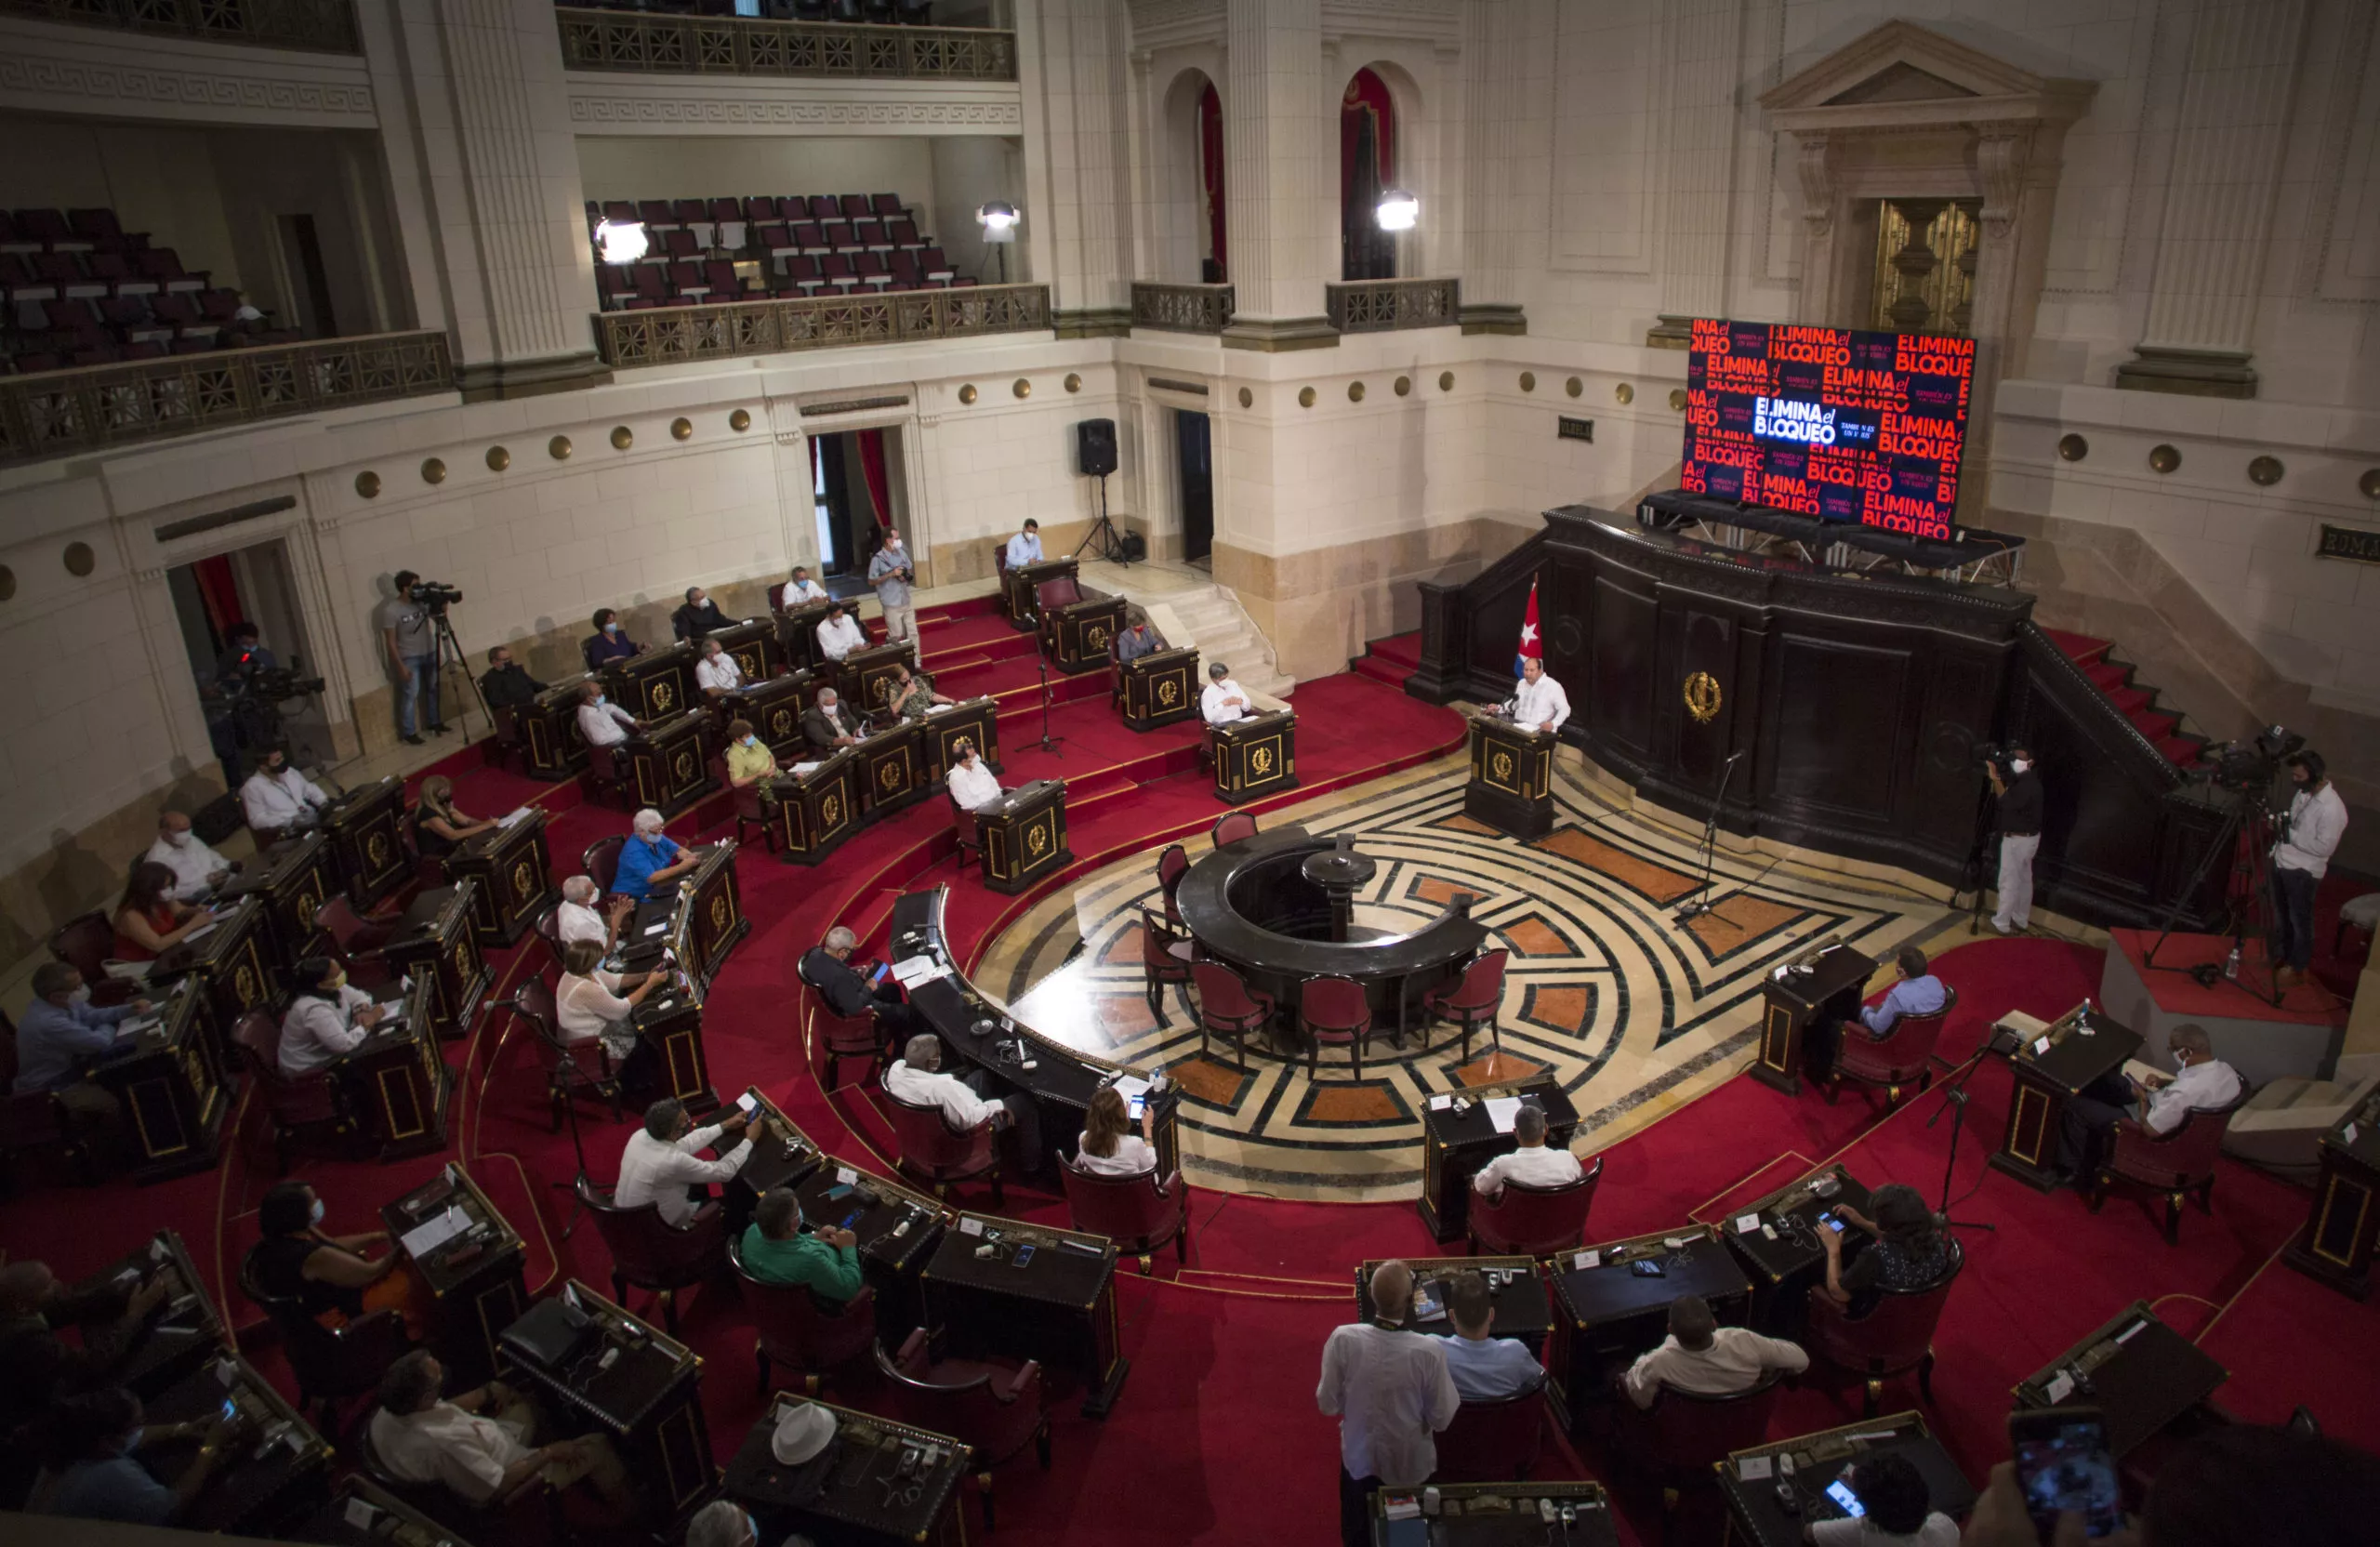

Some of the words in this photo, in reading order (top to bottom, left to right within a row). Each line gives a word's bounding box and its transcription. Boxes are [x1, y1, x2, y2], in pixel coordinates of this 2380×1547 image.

[1897, 335, 1975, 356] ELIMINA
[1707, 354, 1768, 377] ELIMINA
[1824, 365, 1895, 391] ELIMINA
[1755, 396, 1822, 422] ELIMINA
[1822, 408, 1836, 425] el
[1754, 415, 1836, 444] BLOQUEO
[1881, 412, 1956, 441] ELIMINA
[1807, 461, 1893, 492] BLOQUEO
[1864, 490, 1936, 521] ELIMINA
[1937, 508, 1950, 522] el
